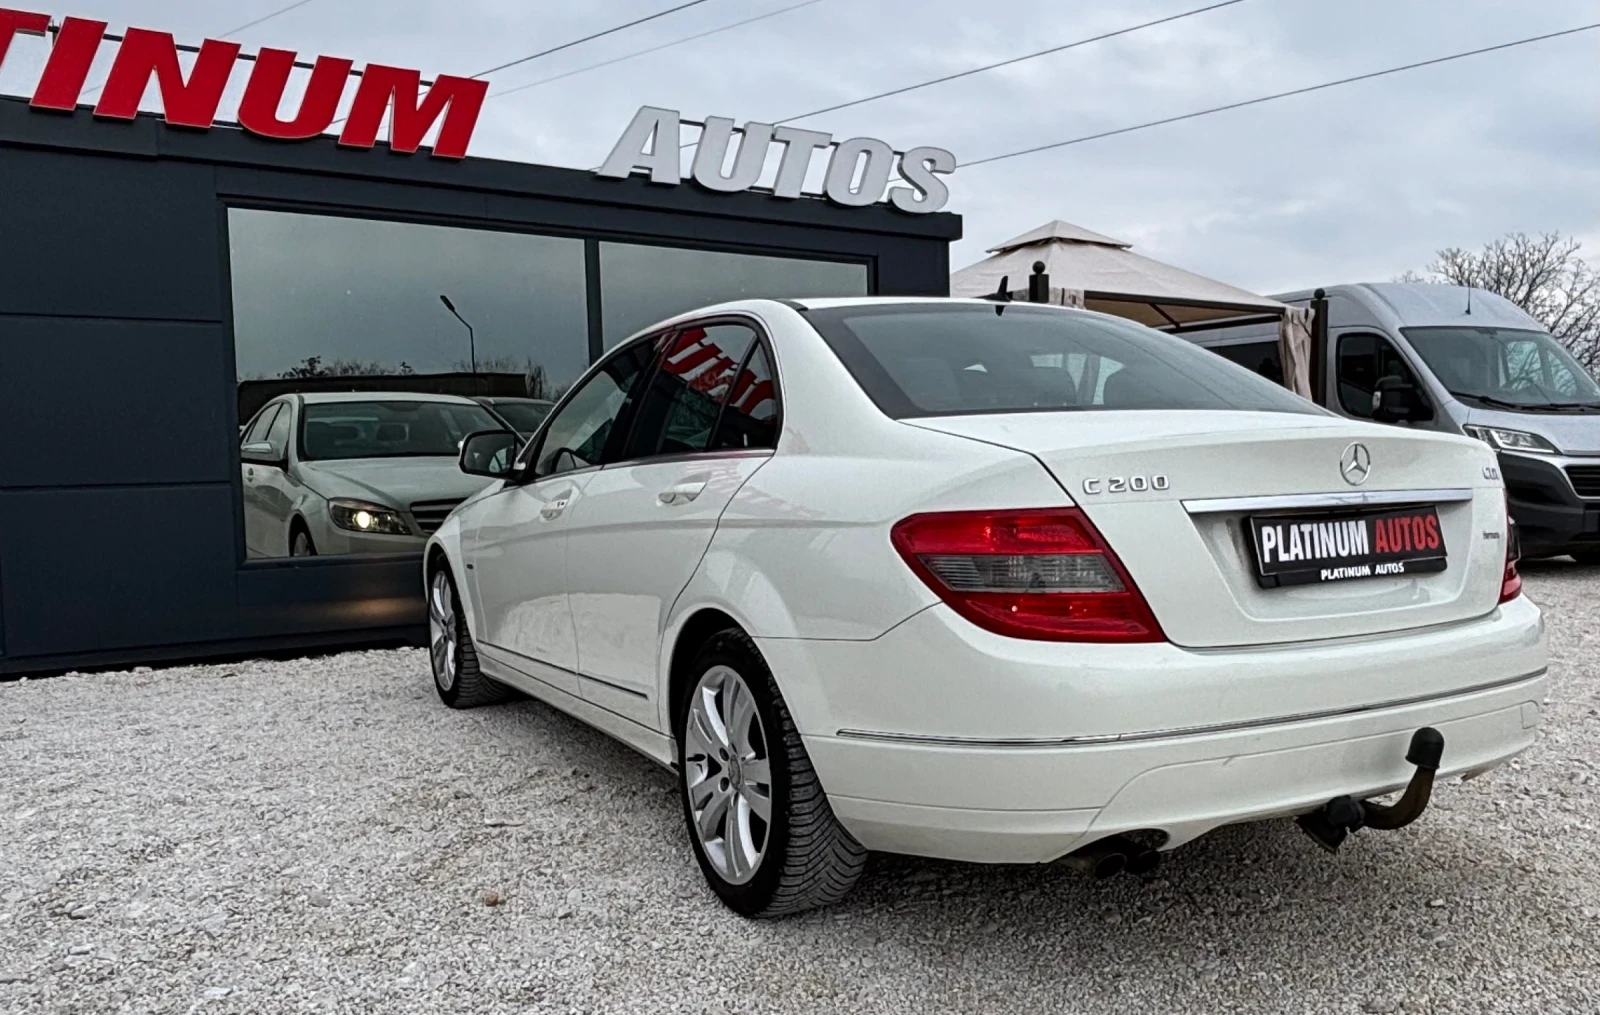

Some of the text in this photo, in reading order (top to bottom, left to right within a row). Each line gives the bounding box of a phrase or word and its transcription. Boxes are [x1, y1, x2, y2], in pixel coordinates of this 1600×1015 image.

[596, 105, 956, 214] AUTOS
[1083, 474, 1170, 494] C 200
[1261, 514, 1439, 563] PLATINUM AUTOS
[1320, 562, 1404, 580] PLATINUM AUTOS
